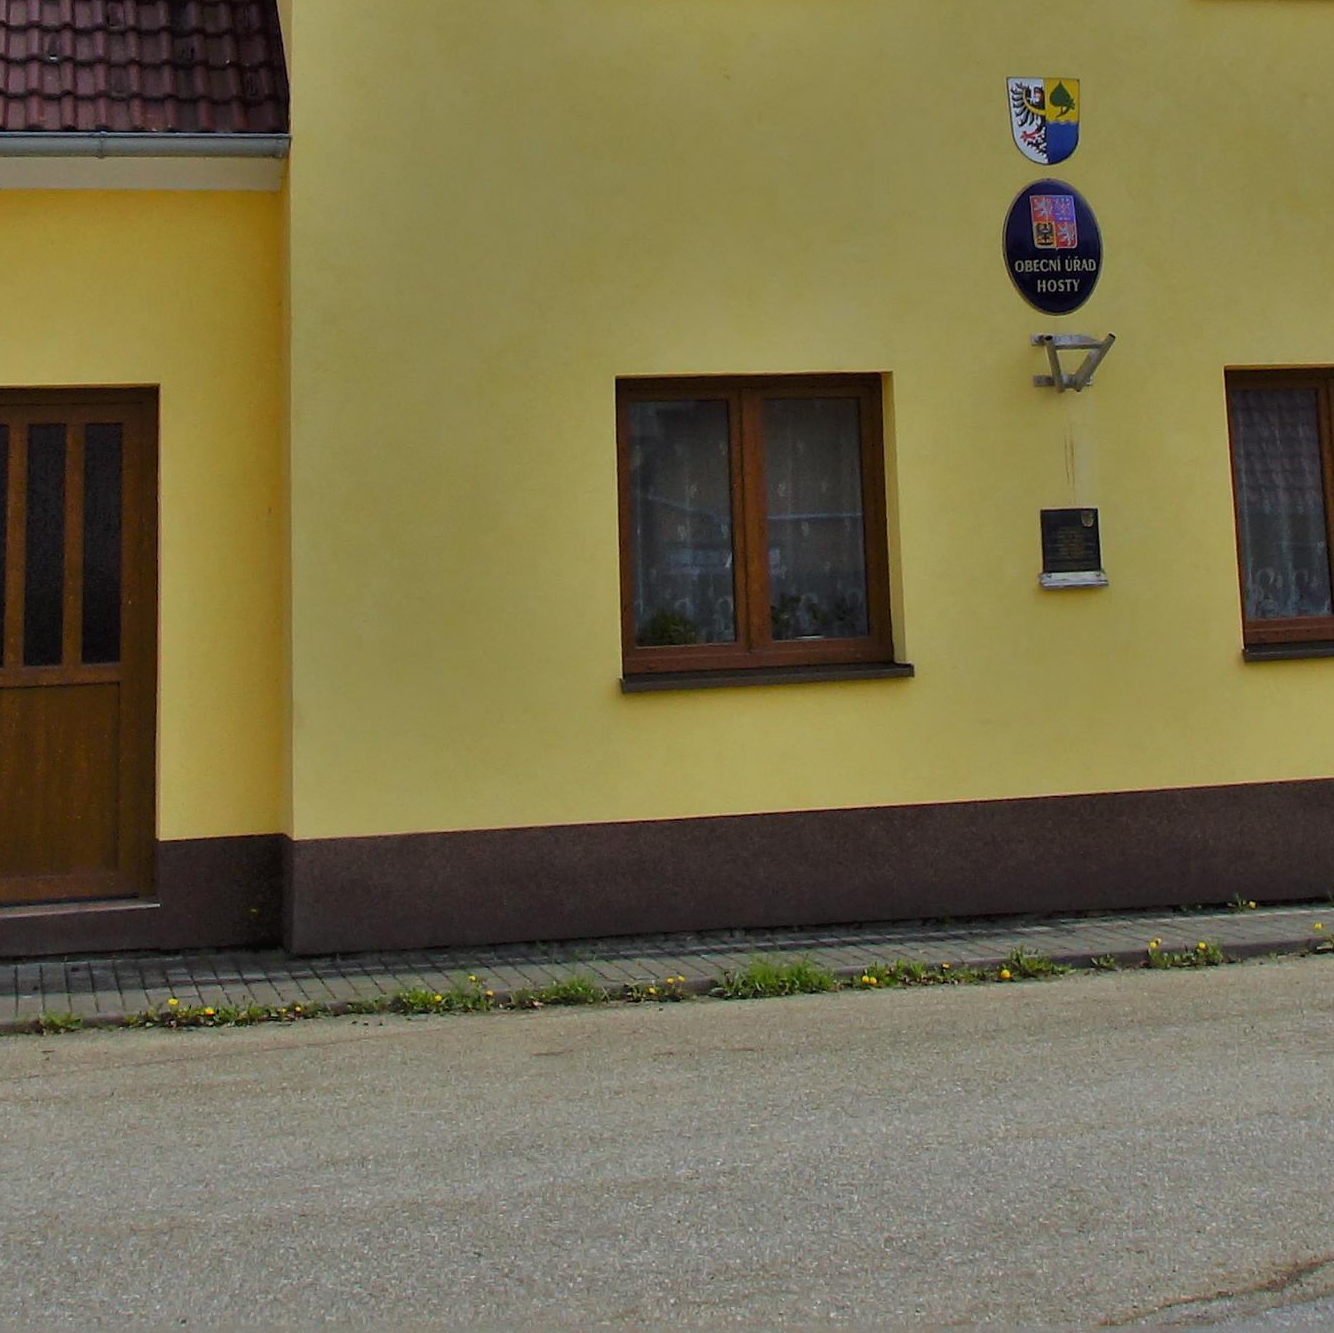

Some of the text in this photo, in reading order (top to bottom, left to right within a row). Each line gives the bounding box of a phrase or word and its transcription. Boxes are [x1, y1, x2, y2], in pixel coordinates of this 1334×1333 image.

[1014, 255, 1097, 273] OBECNÍ ÚŘAD
[1037, 278, 1080, 293] HOSTY
